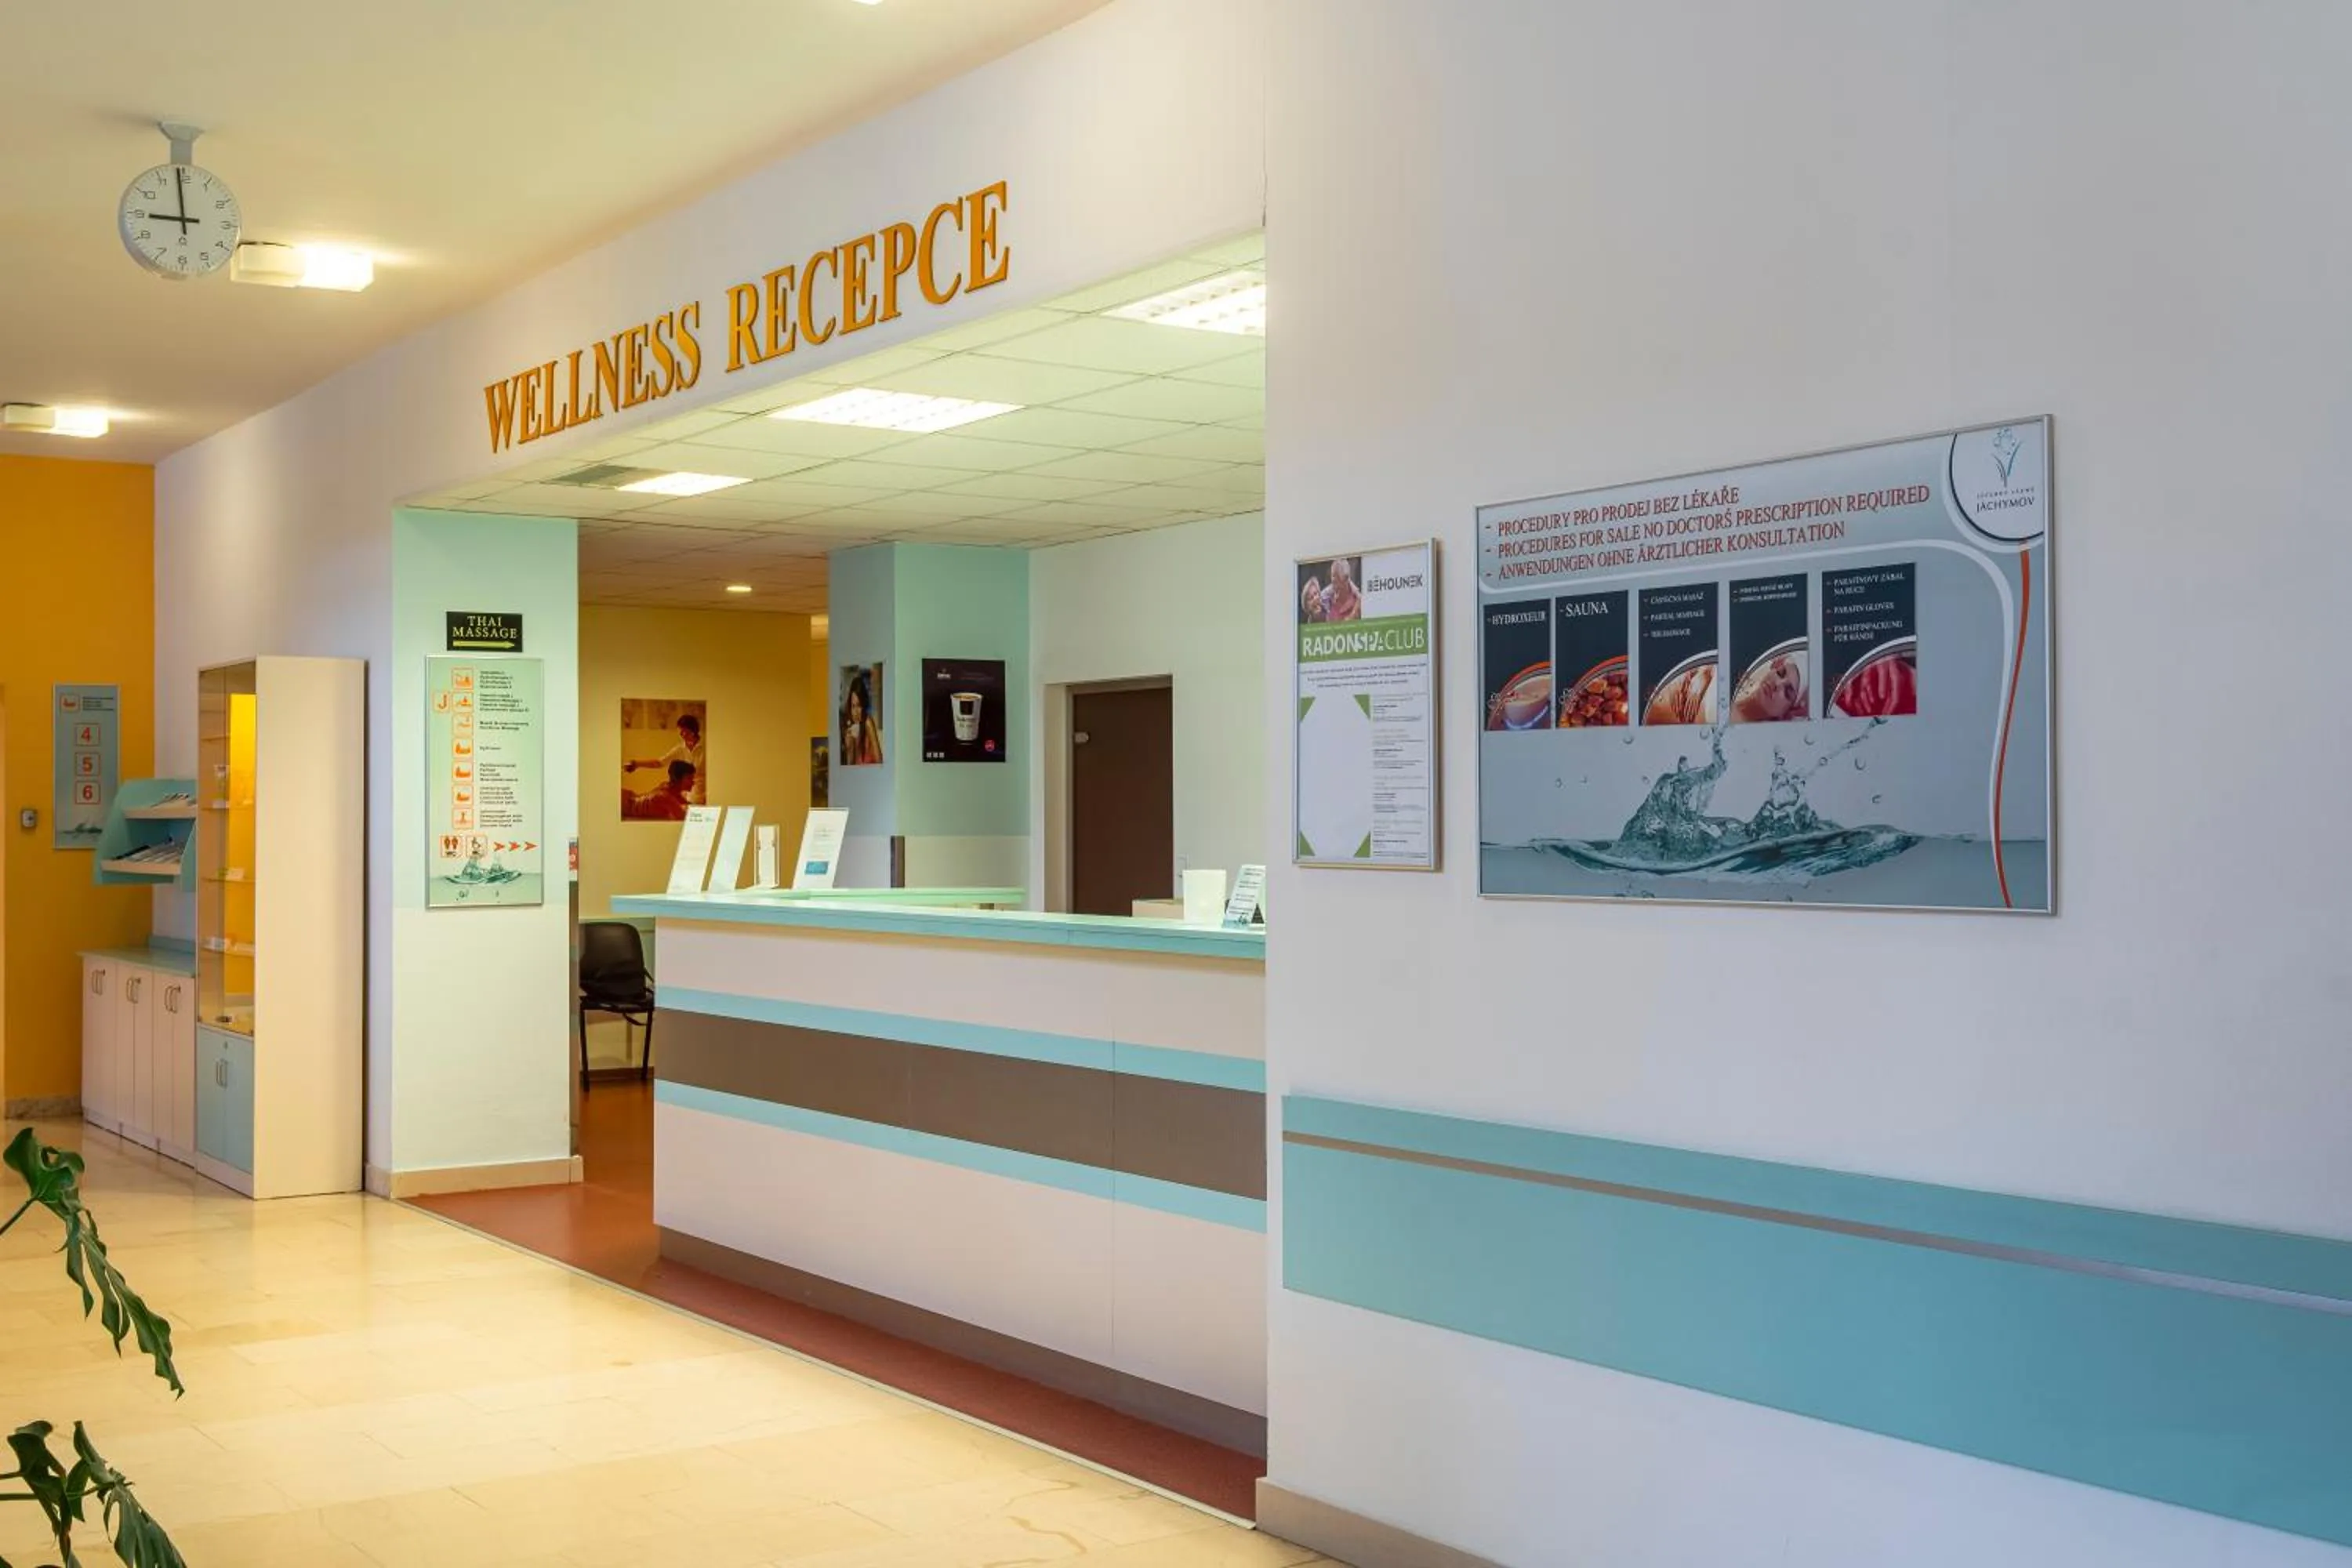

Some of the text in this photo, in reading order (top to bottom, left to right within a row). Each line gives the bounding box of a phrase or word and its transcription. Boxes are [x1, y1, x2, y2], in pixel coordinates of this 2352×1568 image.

[484, 180, 1010, 453] WELLNESS RECEPCE
[1498, 485, 1740, 537] PROCEDURY PRO PRODEJ BEZ LÉKAŘE
[1498, 535, 1577, 558] PROCEDURES
[1579, 529, 1604, 548] FOR
[1607, 524, 1641, 544] SALE
[1644, 521, 1664, 539] NO
[1735, 496, 1843, 528] PRESCRIPTION
[1846, 485, 1930, 513] REQUIRED
[1498, 554, 1594, 580] ANWENDUNGEN
[1597, 548, 1635, 568] OHNE
[1727, 521, 1845, 553] KONSULTATION
[1566, 601, 1609, 617] SAUNA
[467, 615, 502, 626] THAI
[452, 626, 517, 639] MASSAGE
[1385, 627, 1425, 651] CLUB
[81, 726, 91, 742] 4
[82, 757, 93, 772] 5
[82, 785, 93, 800] 6
